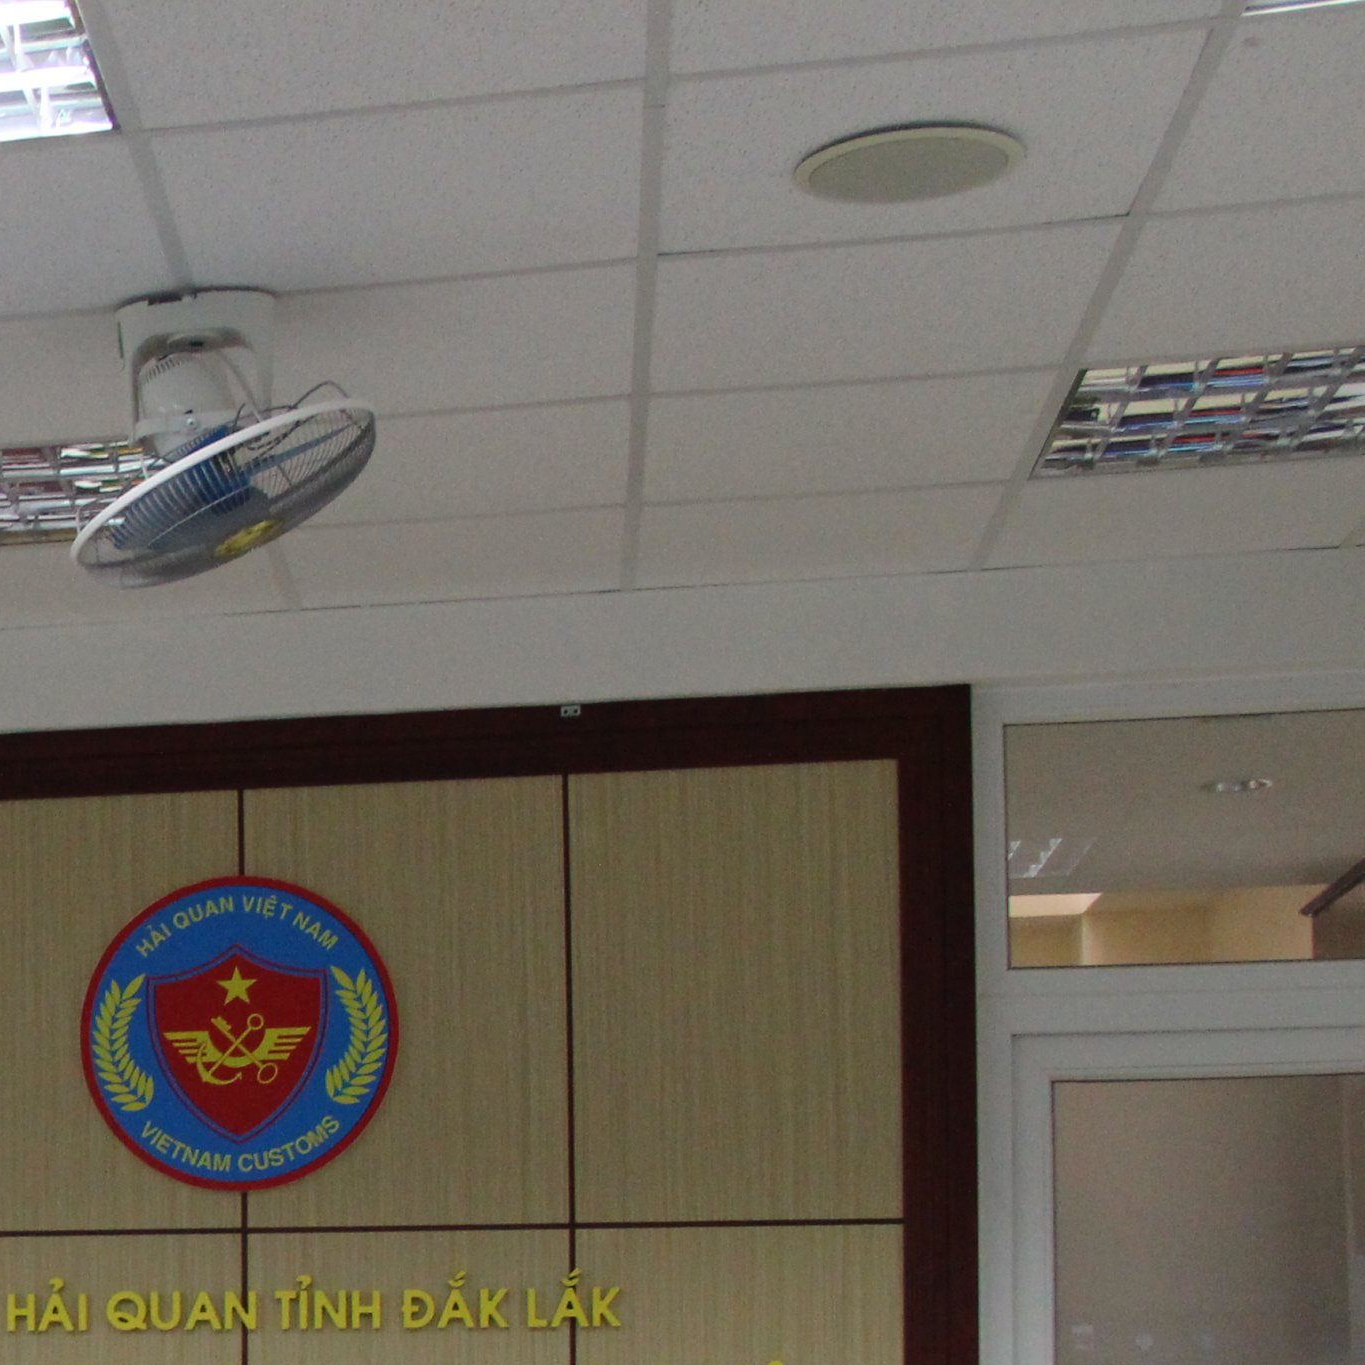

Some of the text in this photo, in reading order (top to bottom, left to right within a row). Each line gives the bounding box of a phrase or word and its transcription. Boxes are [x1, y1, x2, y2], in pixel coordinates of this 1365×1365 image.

[136, 894, 340, 958] HẢI QUAN VIỆT NAM
[140, 1115, 341, 1173] VIETNAM CUSTOMS
[6, 1278, 90, 1333] HẢI
[106, 1290, 258, 1331] QUAN
[274, 1274, 381, 1330] TỈNH
[401, 1270, 510, 1330] ĐẮK
[526, 1267, 622, 1329] LẮK
